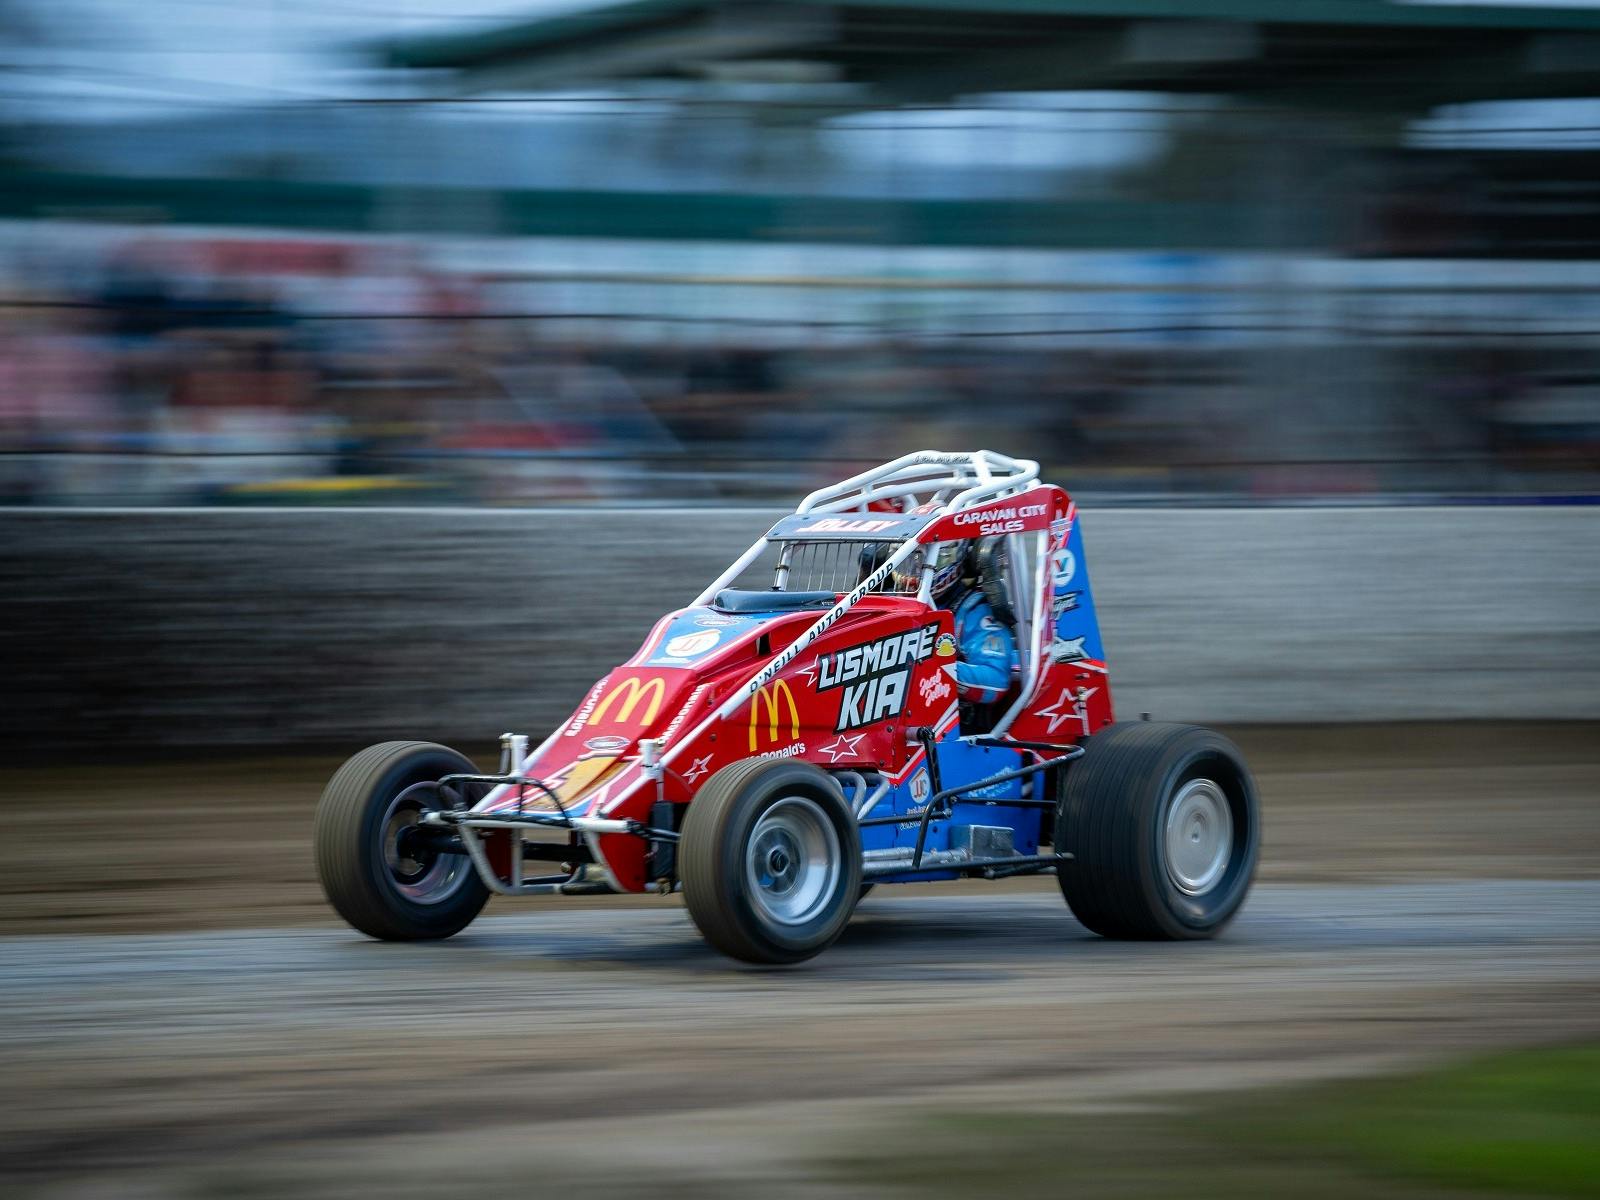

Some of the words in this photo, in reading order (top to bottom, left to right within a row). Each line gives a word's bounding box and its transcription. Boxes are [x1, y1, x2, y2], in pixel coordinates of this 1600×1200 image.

[953, 507, 1017, 526] CARAVAN
[1018, 503, 1048, 518] CITY
[980, 520, 1025, 536] SALES
[808, 606, 844, 644] AUTO
[850, 562, 894, 607] GROUP
[818, 624, 939, 689] LISMORE
[837, 669, 909, 731] KIA
[746, 742, 806, 760] Donald's
